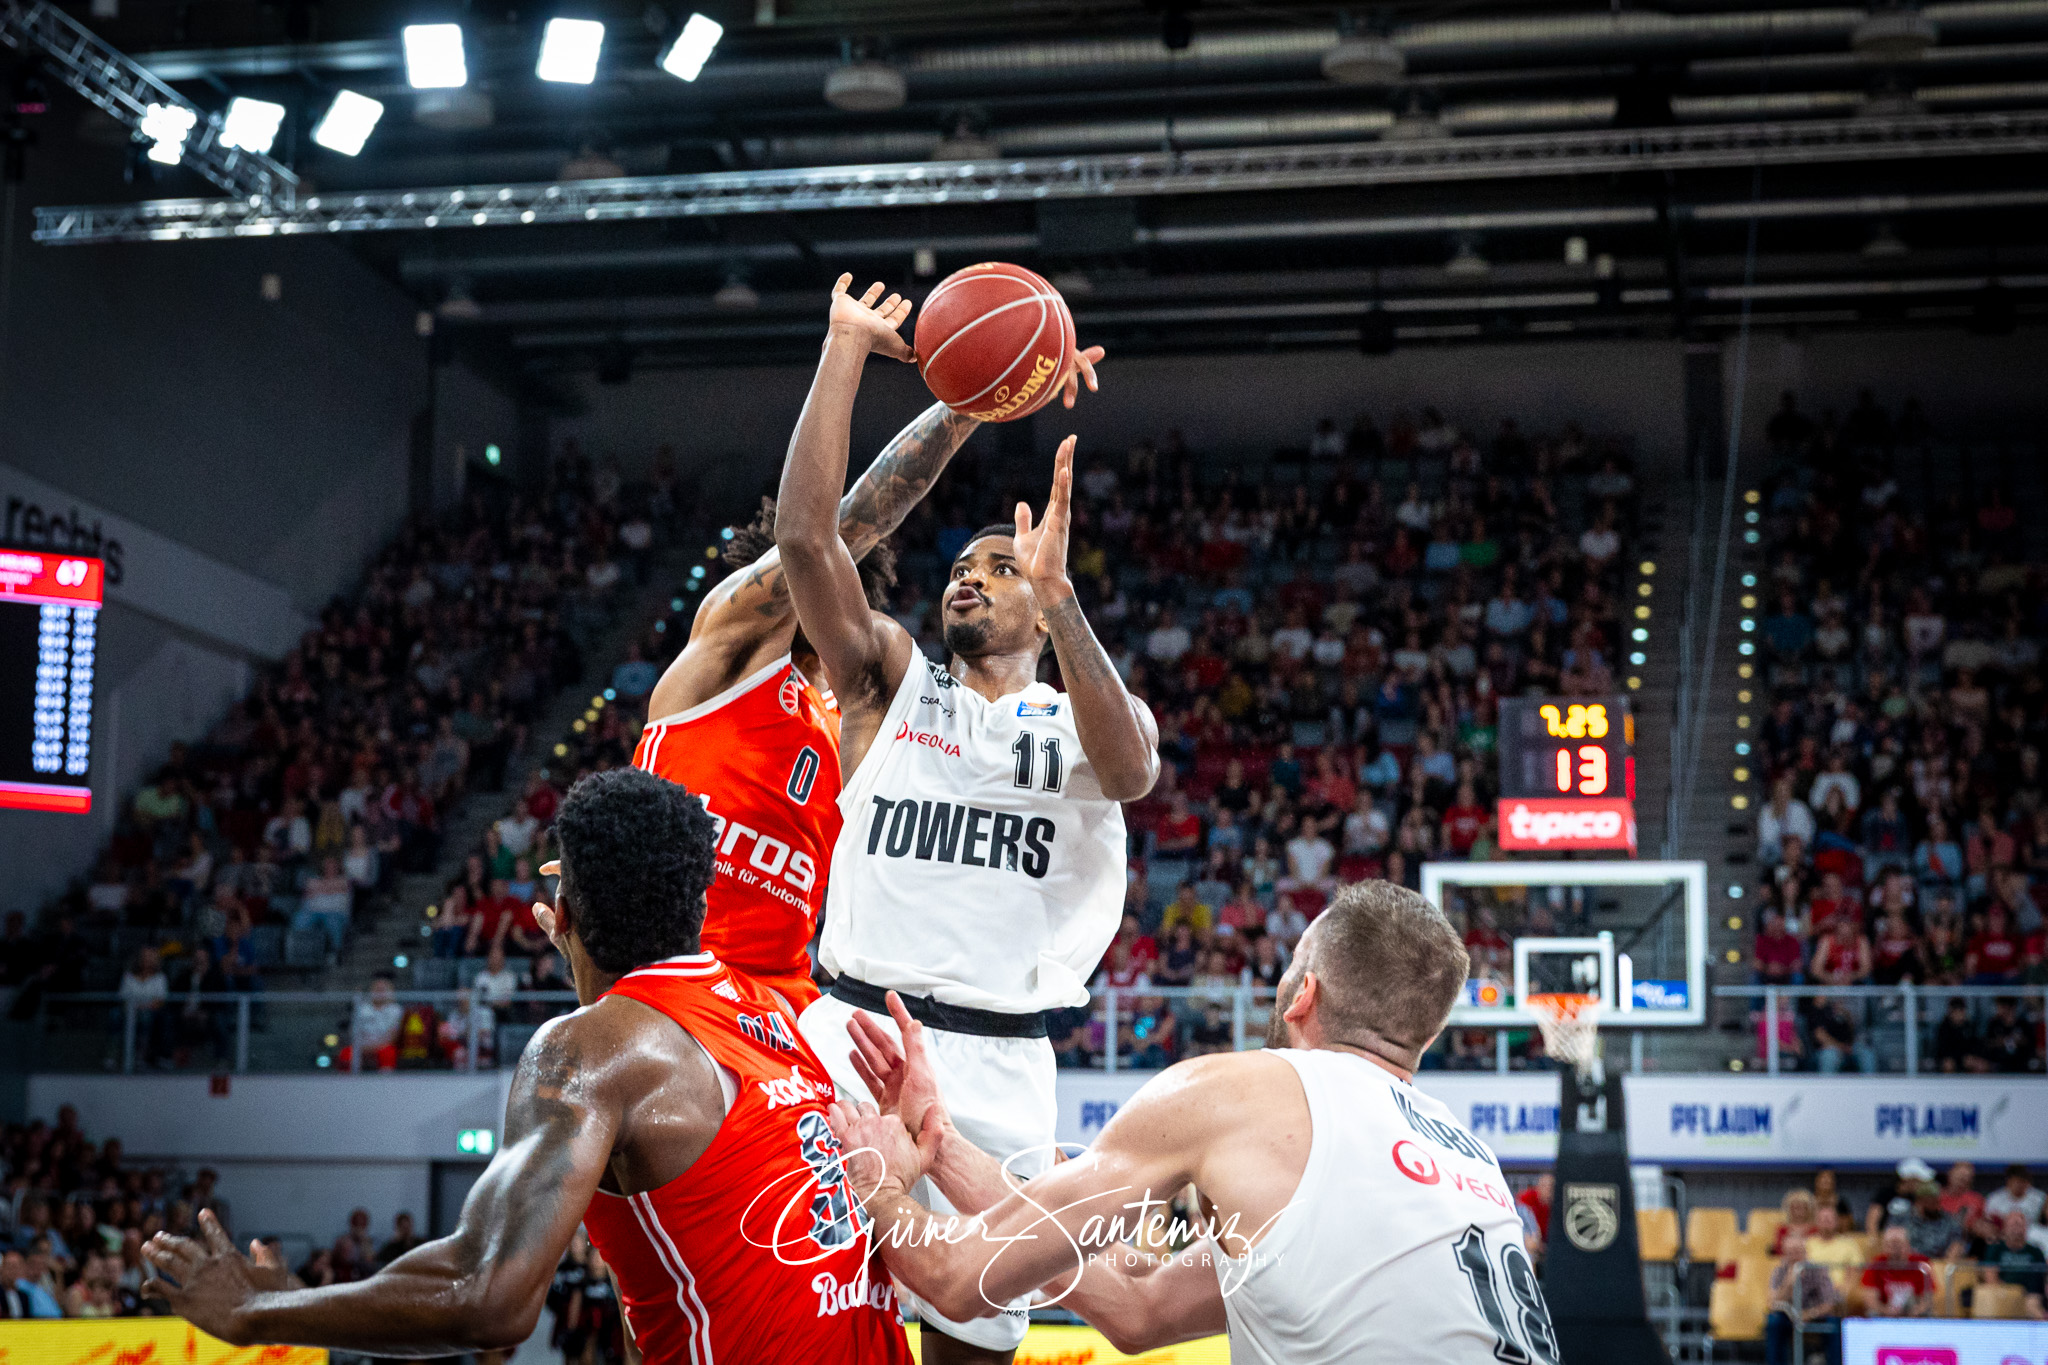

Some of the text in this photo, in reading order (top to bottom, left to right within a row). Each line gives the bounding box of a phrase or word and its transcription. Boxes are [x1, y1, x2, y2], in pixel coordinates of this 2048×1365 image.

[909, 731, 961, 758] VEOLIA
[1012, 730, 1064, 793] 11
[786, 745, 820, 806] 0
[1556, 745, 1608, 795] 13
[866, 794, 1057, 879] TOWERS
[1508, 804, 1622, 845] tipico
[737, 868, 760, 886] für
[1670, 1102, 1772, 1136] PFLAUM
[1876, 1102, 1980, 1137] PFLAUM
